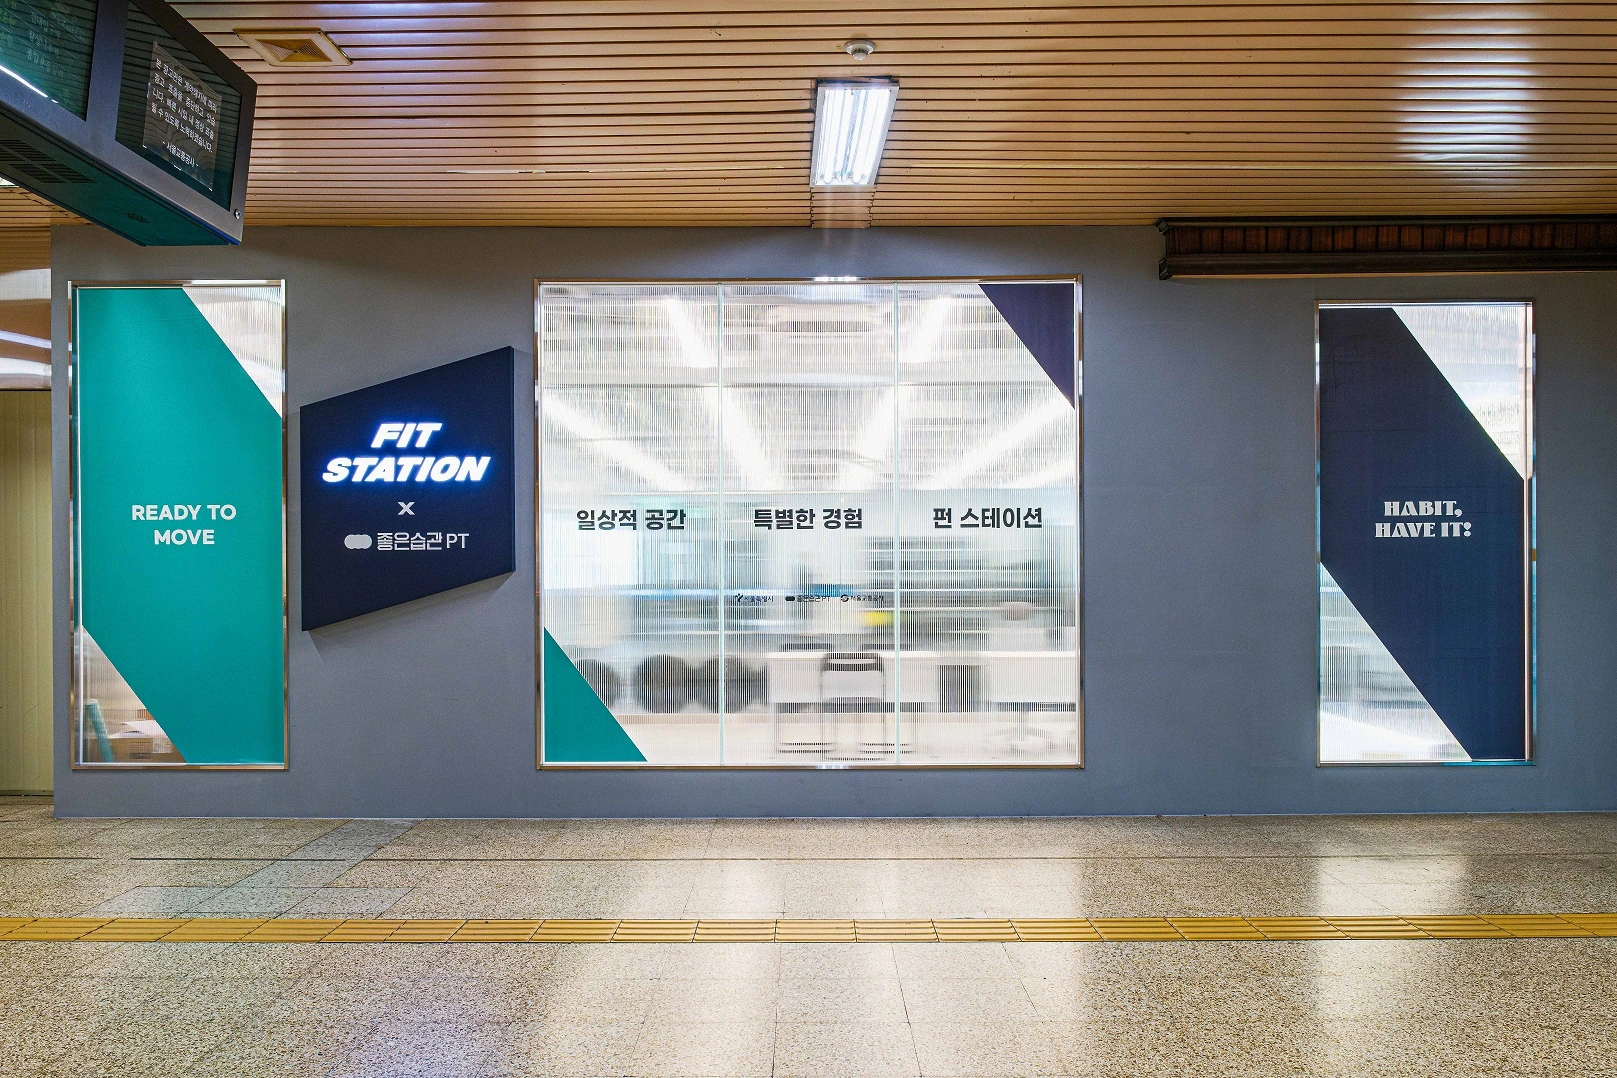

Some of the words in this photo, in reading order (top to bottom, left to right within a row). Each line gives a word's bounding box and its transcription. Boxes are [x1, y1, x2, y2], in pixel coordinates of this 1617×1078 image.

[185, 96, 204, 118] 중단하고
[164, 111, 180, 130] 있도록
[166, 141, 195, 168] 서울교통공사
[371, 423, 443, 448] FIT
[322, 456, 491, 483] STATION
[131, 504, 202, 521] READY
[206, 504, 237, 521] TO
[576, 509, 637, 531] 일상적
[645, 509, 687, 531] 공간
[753, 508, 816, 531] 특별한
[822, 508, 863, 530] 경험
[933, 507, 952, 529] 펀
[960, 507, 1043, 529] 스테이션
[1384, 500, 1463, 518] HABIT,
[154, 529, 216, 545] MOVE
[1374, 522, 1436, 538] HAVE
[744, 595, 774, 603] 서울특별시
